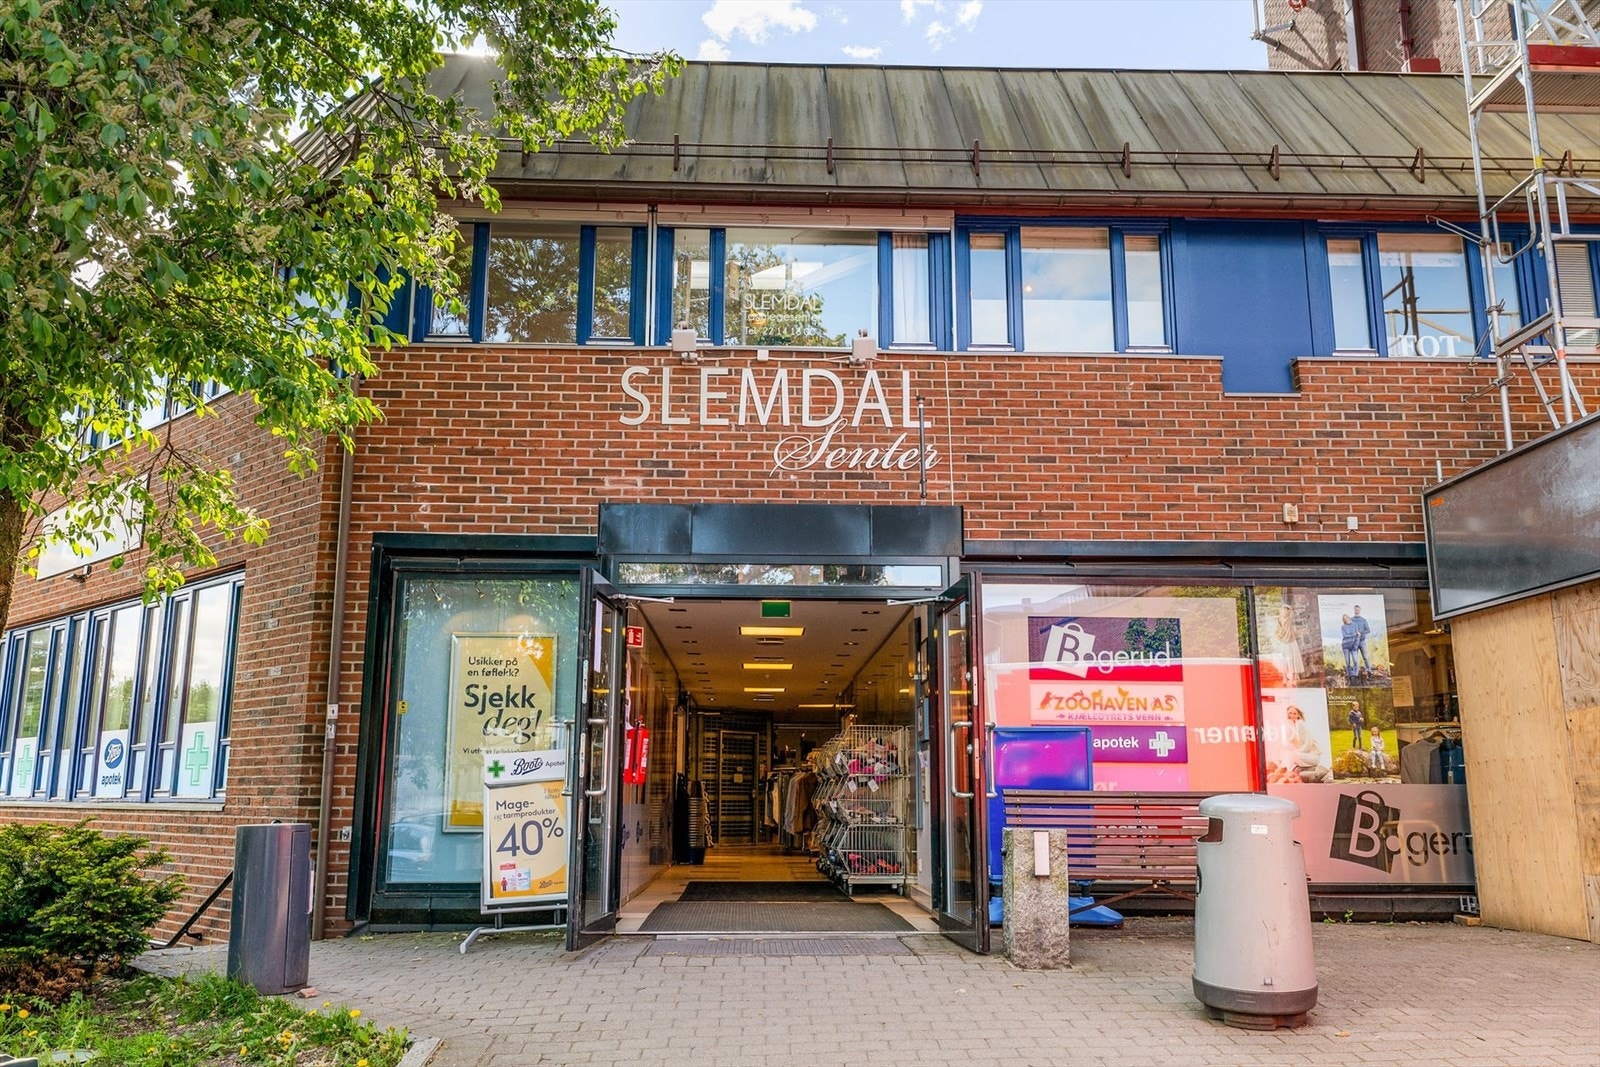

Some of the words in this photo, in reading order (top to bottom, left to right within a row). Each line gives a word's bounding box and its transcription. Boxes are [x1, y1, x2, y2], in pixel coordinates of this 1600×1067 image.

[743, 293, 822, 311] SLEMDAL
[618, 365, 932, 428] SLEMDAL
[768, 417, 943, 478] Senter
[1055, 630, 1170, 674] Bogerud
[468, 656, 503, 666] Usikker
[505, 657, 518, 668] på
[467, 669, 479, 677] en
[481, 668, 520, 678] føflekk?
[464, 683, 536, 715] Sjekk
[1054, 695, 1148, 711] ZOOHAVEN
[1151, 695, 1175, 711] AS
[482, 709, 543, 745] deg!
[1093, 737, 1139, 749] apotek
[511, 757, 543, 776] Boots
[101, 772, 121, 787] apotek
[496, 800, 534, 812] Mage-
[503, 808, 556, 819] tarmprodukter
[496, 816, 564, 857] 40%
